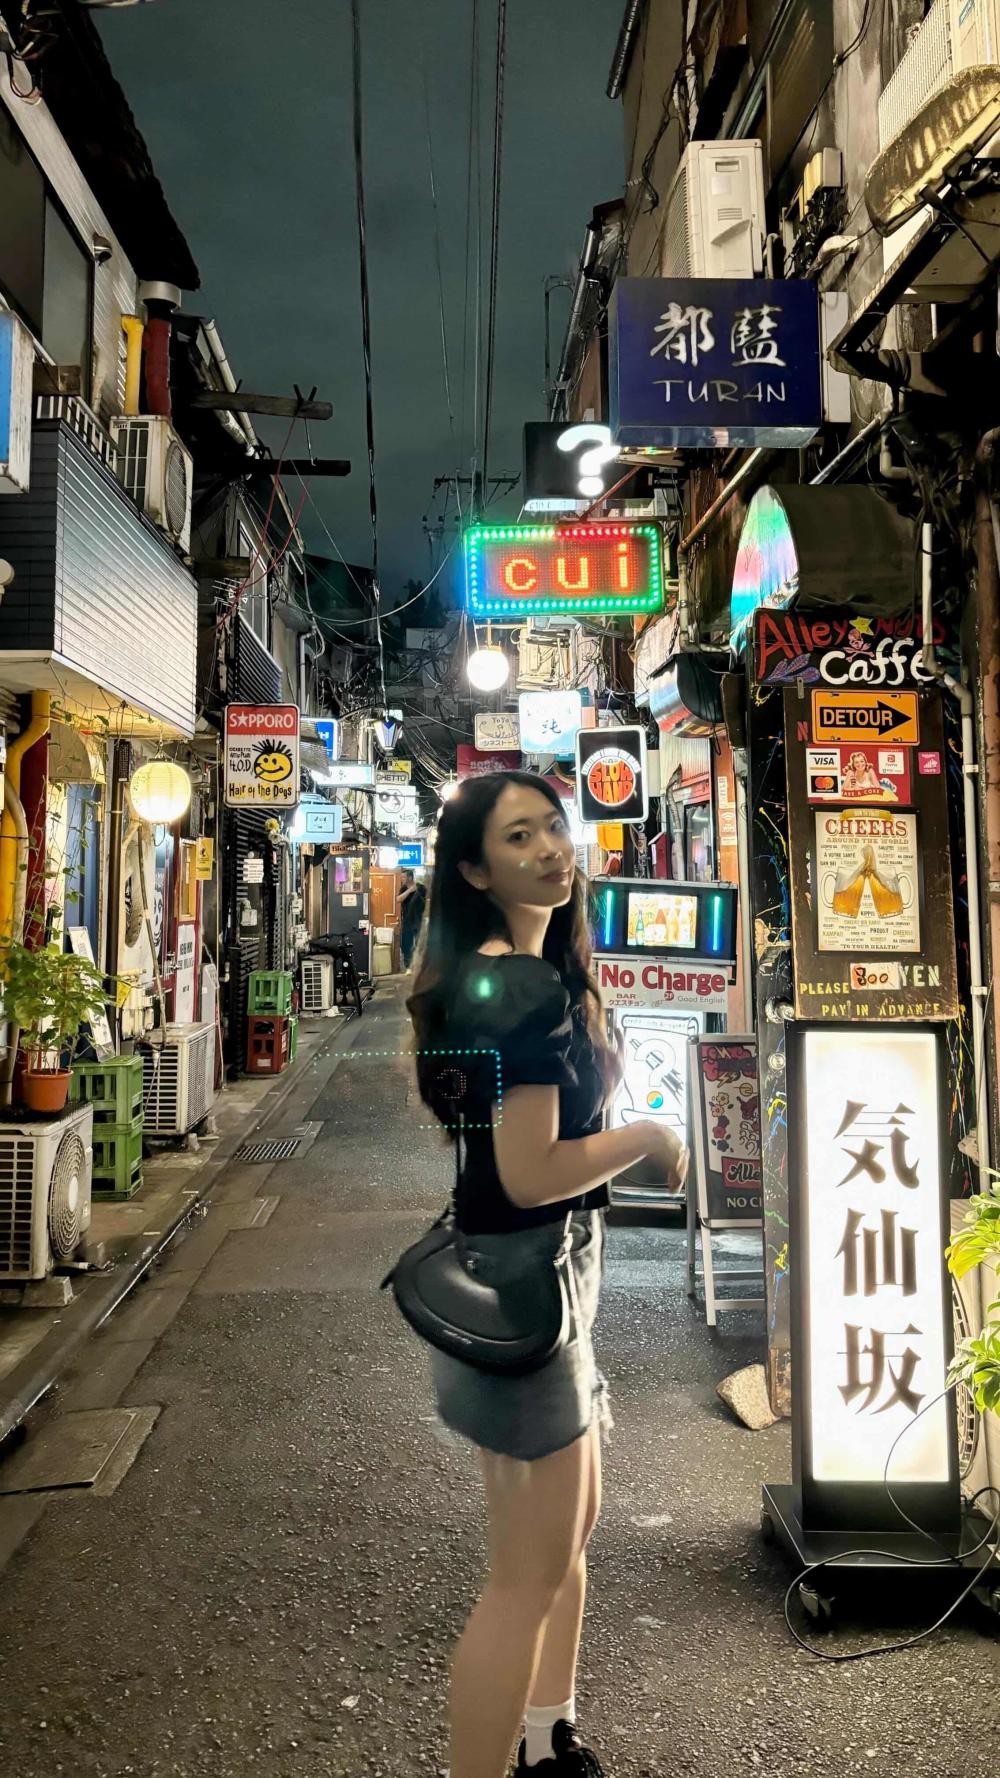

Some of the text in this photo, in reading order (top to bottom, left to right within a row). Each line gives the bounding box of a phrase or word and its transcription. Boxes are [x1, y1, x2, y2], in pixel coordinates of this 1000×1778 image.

[652, 379, 786, 402] TURAN
[757, 613, 849, 679] Alley
[823, 709, 893, 726] DETOUR
[813, 757, 835, 765] VISA
[229, 783, 246, 797] Hair
[257, 783, 271, 796] the
[273, 784, 292, 799] Dogs
[825, 819, 908, 836] CHEERS
[601, 964, 726, 996] No Charge
[901, 965, 941, 987] YEN
[800, 982, 849, 995] PLEASE
[677, 995, 698, 1003] Good
[821, 1003, 941, 1017] PAY IN ADVANCE
[727, 1197, 747, 1208] NO
[833, 1099, 927, 1416] 気仙坂
